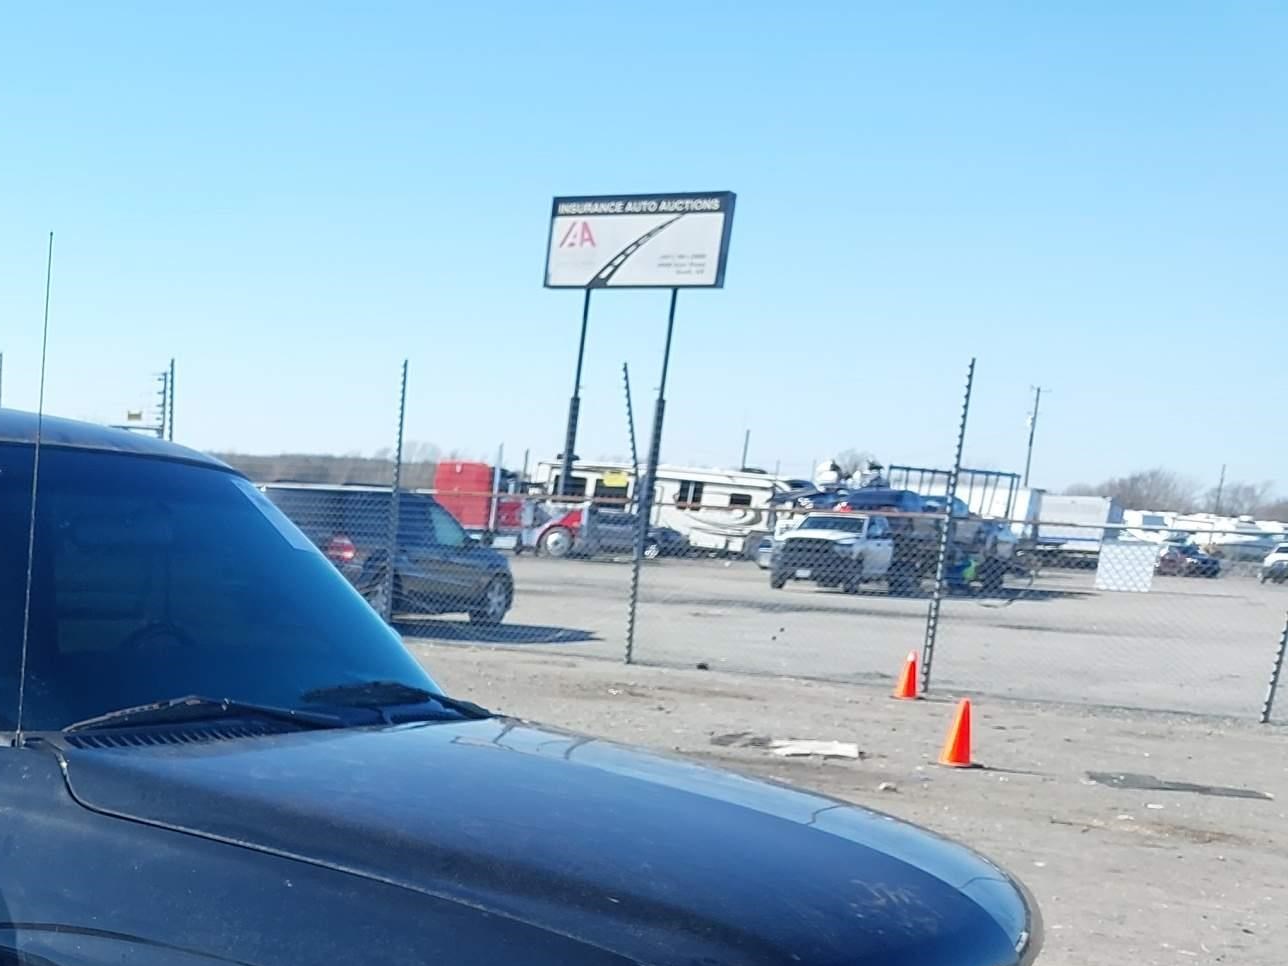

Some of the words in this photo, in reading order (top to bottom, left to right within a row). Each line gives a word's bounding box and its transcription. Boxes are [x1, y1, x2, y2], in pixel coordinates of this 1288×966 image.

[558, 202, 624, 215] INSURANCE
[624, 200, 658, 213] AUTO
[658, 198, 721, 212] AUCTIONS
